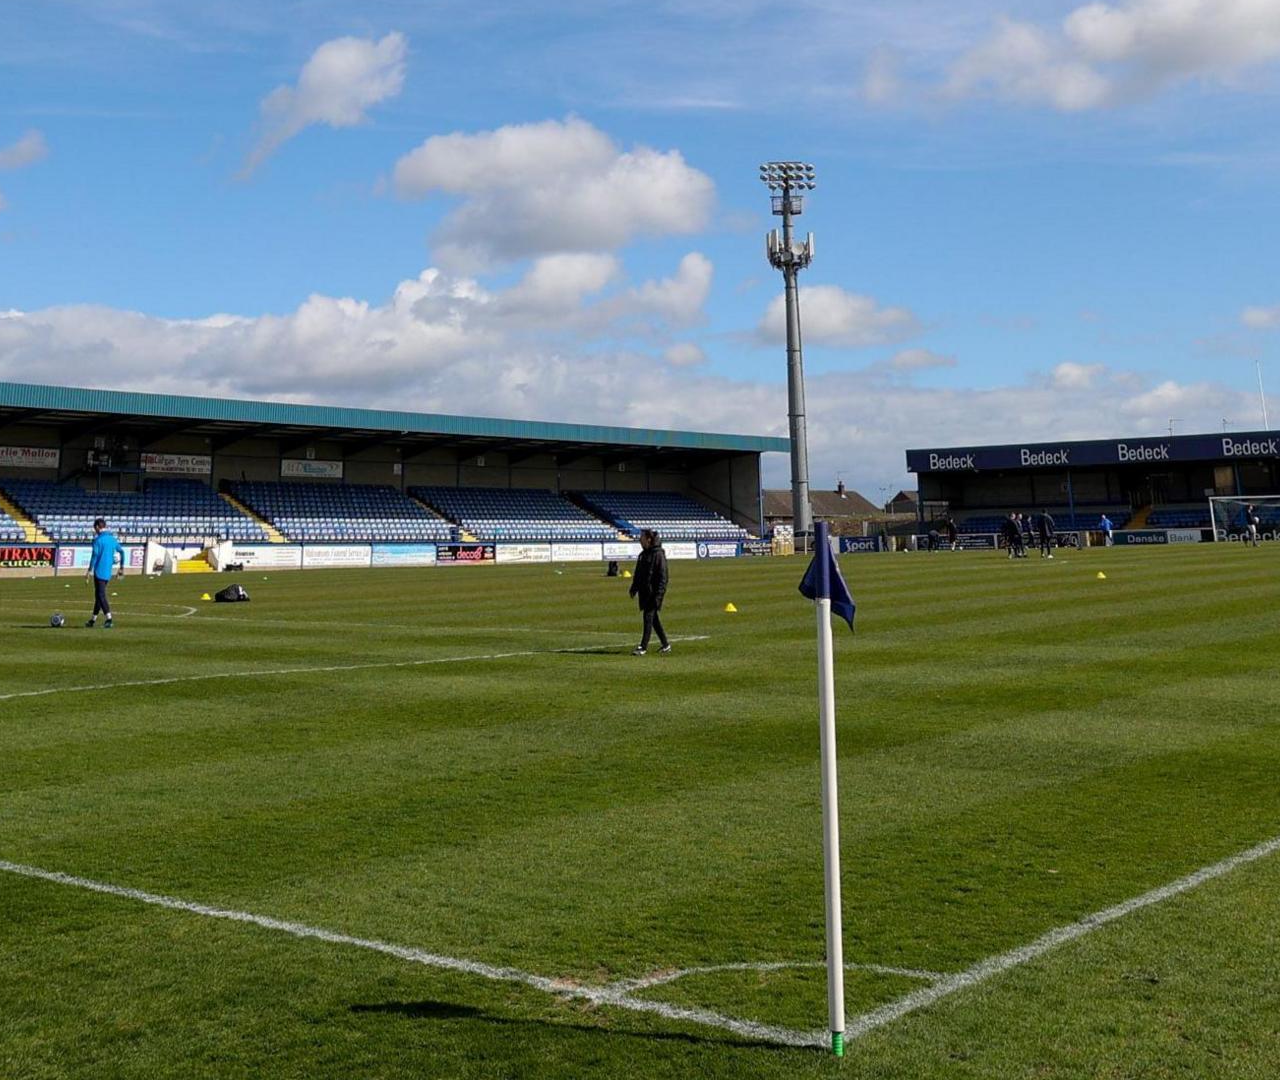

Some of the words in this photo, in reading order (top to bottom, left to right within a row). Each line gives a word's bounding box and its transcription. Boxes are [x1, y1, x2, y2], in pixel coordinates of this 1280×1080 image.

[21, 448, 57, 459] Mallon
[1118, 443, 1169, 461] Bedeck
[1222, 438, 1278, 456] Bedeck
[929, 453, 975, 470] Bedeck
[1021, 449, 1069, 466] Bedeck
[1127, 534, 1165, 543] Danske
[1169, 533, 1194, 542] Bank
